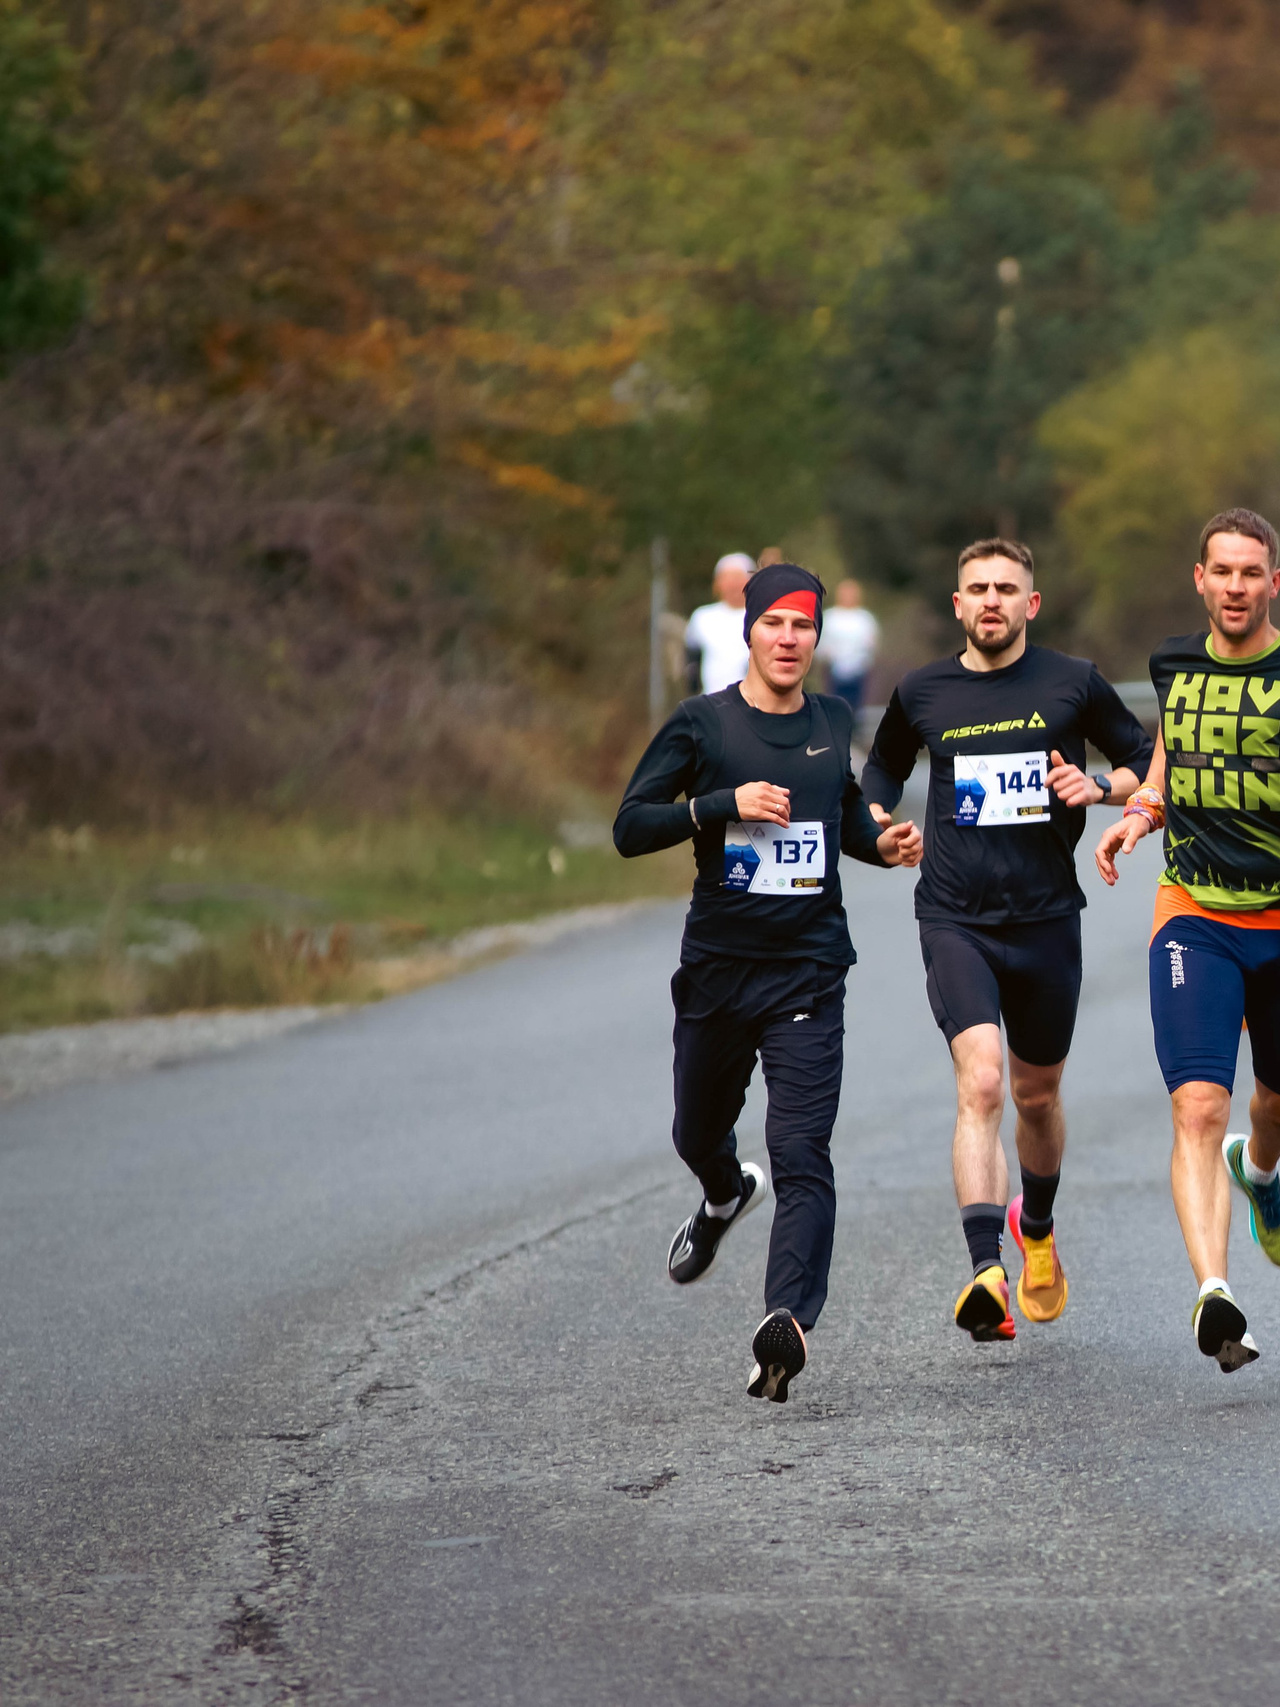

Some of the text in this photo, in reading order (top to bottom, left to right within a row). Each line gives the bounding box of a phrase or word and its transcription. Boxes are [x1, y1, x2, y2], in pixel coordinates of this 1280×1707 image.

[941, 718, 1025, 741] FISCHER
[1164, 711, 1280, 758] KAZ
[996, 769, 1044, 794] 144
[772, 840, 818, 864] 137
